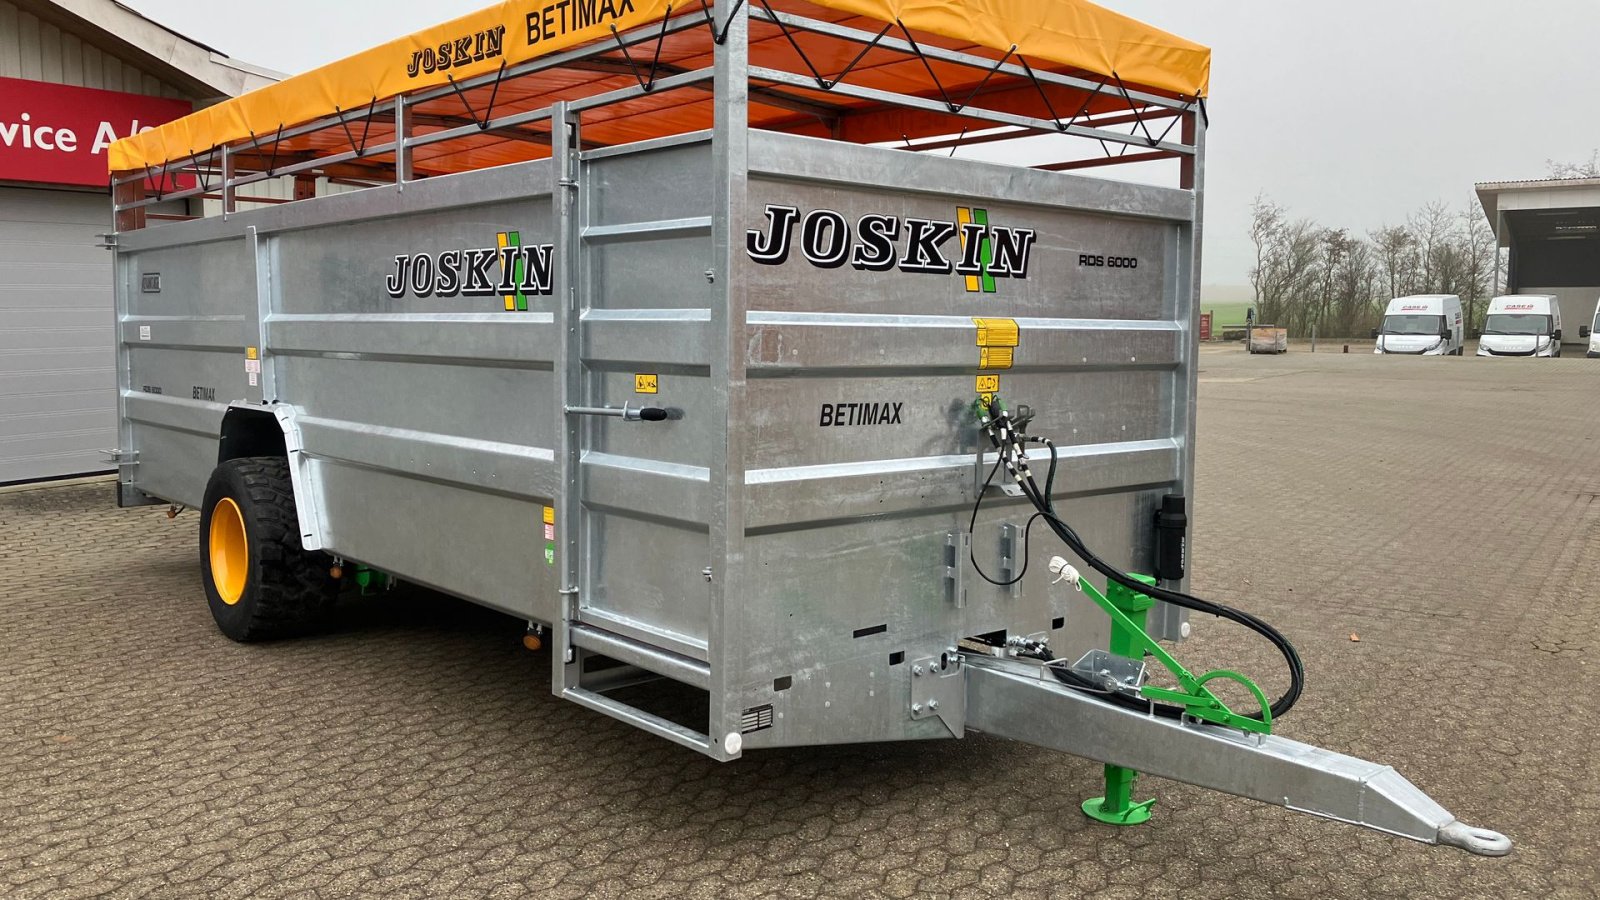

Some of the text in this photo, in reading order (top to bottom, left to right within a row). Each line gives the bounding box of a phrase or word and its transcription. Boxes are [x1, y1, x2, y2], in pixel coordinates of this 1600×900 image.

[407, 24, 506, 78] JOSKIN
[747, 204, 1037, 279] JOSKIN
[386, 243, 554, 298] JOSKIN
[1079, 254, 1138, 269] RDS 6000
[193, 385, 216, 401] BETIMAX
[820, 402, 903, 427] BETIMAX
